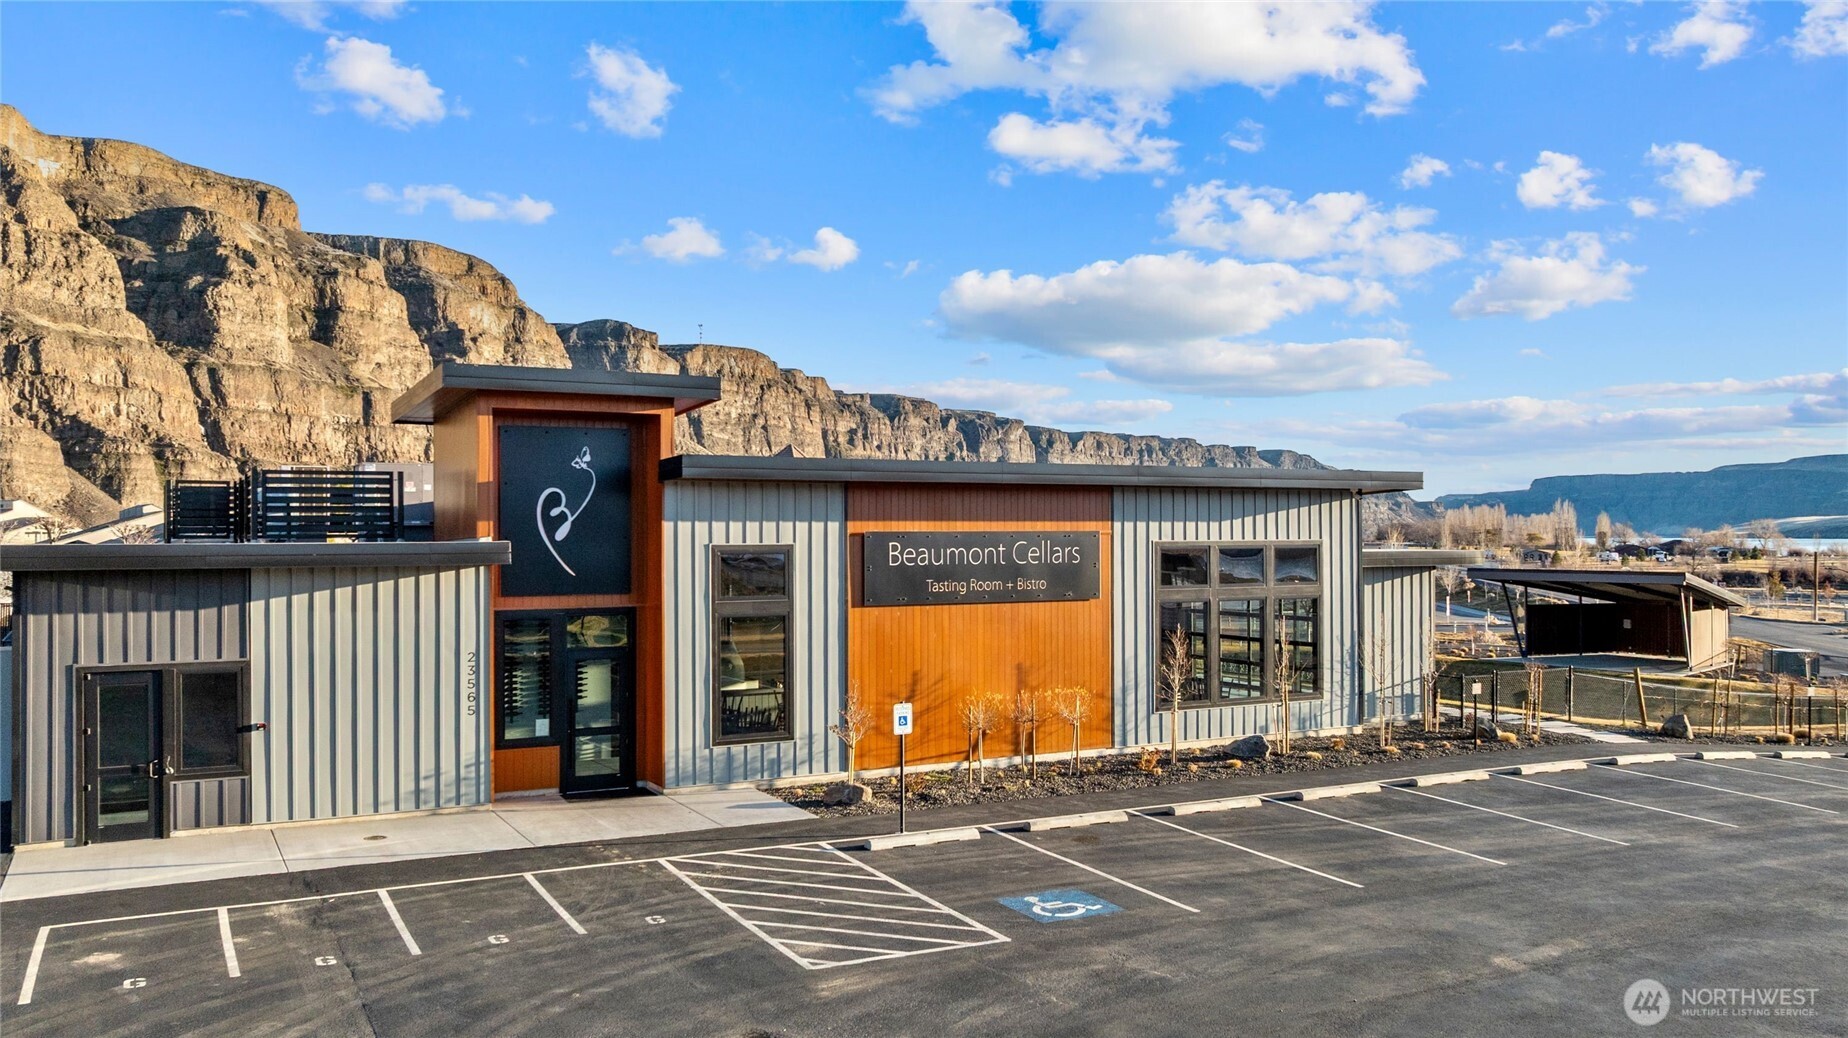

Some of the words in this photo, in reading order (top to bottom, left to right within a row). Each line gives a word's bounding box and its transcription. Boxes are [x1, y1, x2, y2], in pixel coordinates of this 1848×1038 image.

[888, 541, 1007, 567] Beaumont
[1012, 539, 1081, 565] Cellars
[926, 579, 967, 595] Tasting
[969, 578, 1003, 592] Room
[1005, 580, 1015, 590] +
[1017, 577, 1048, 590] Bistro
[467, 651, 476, 716] 23565
